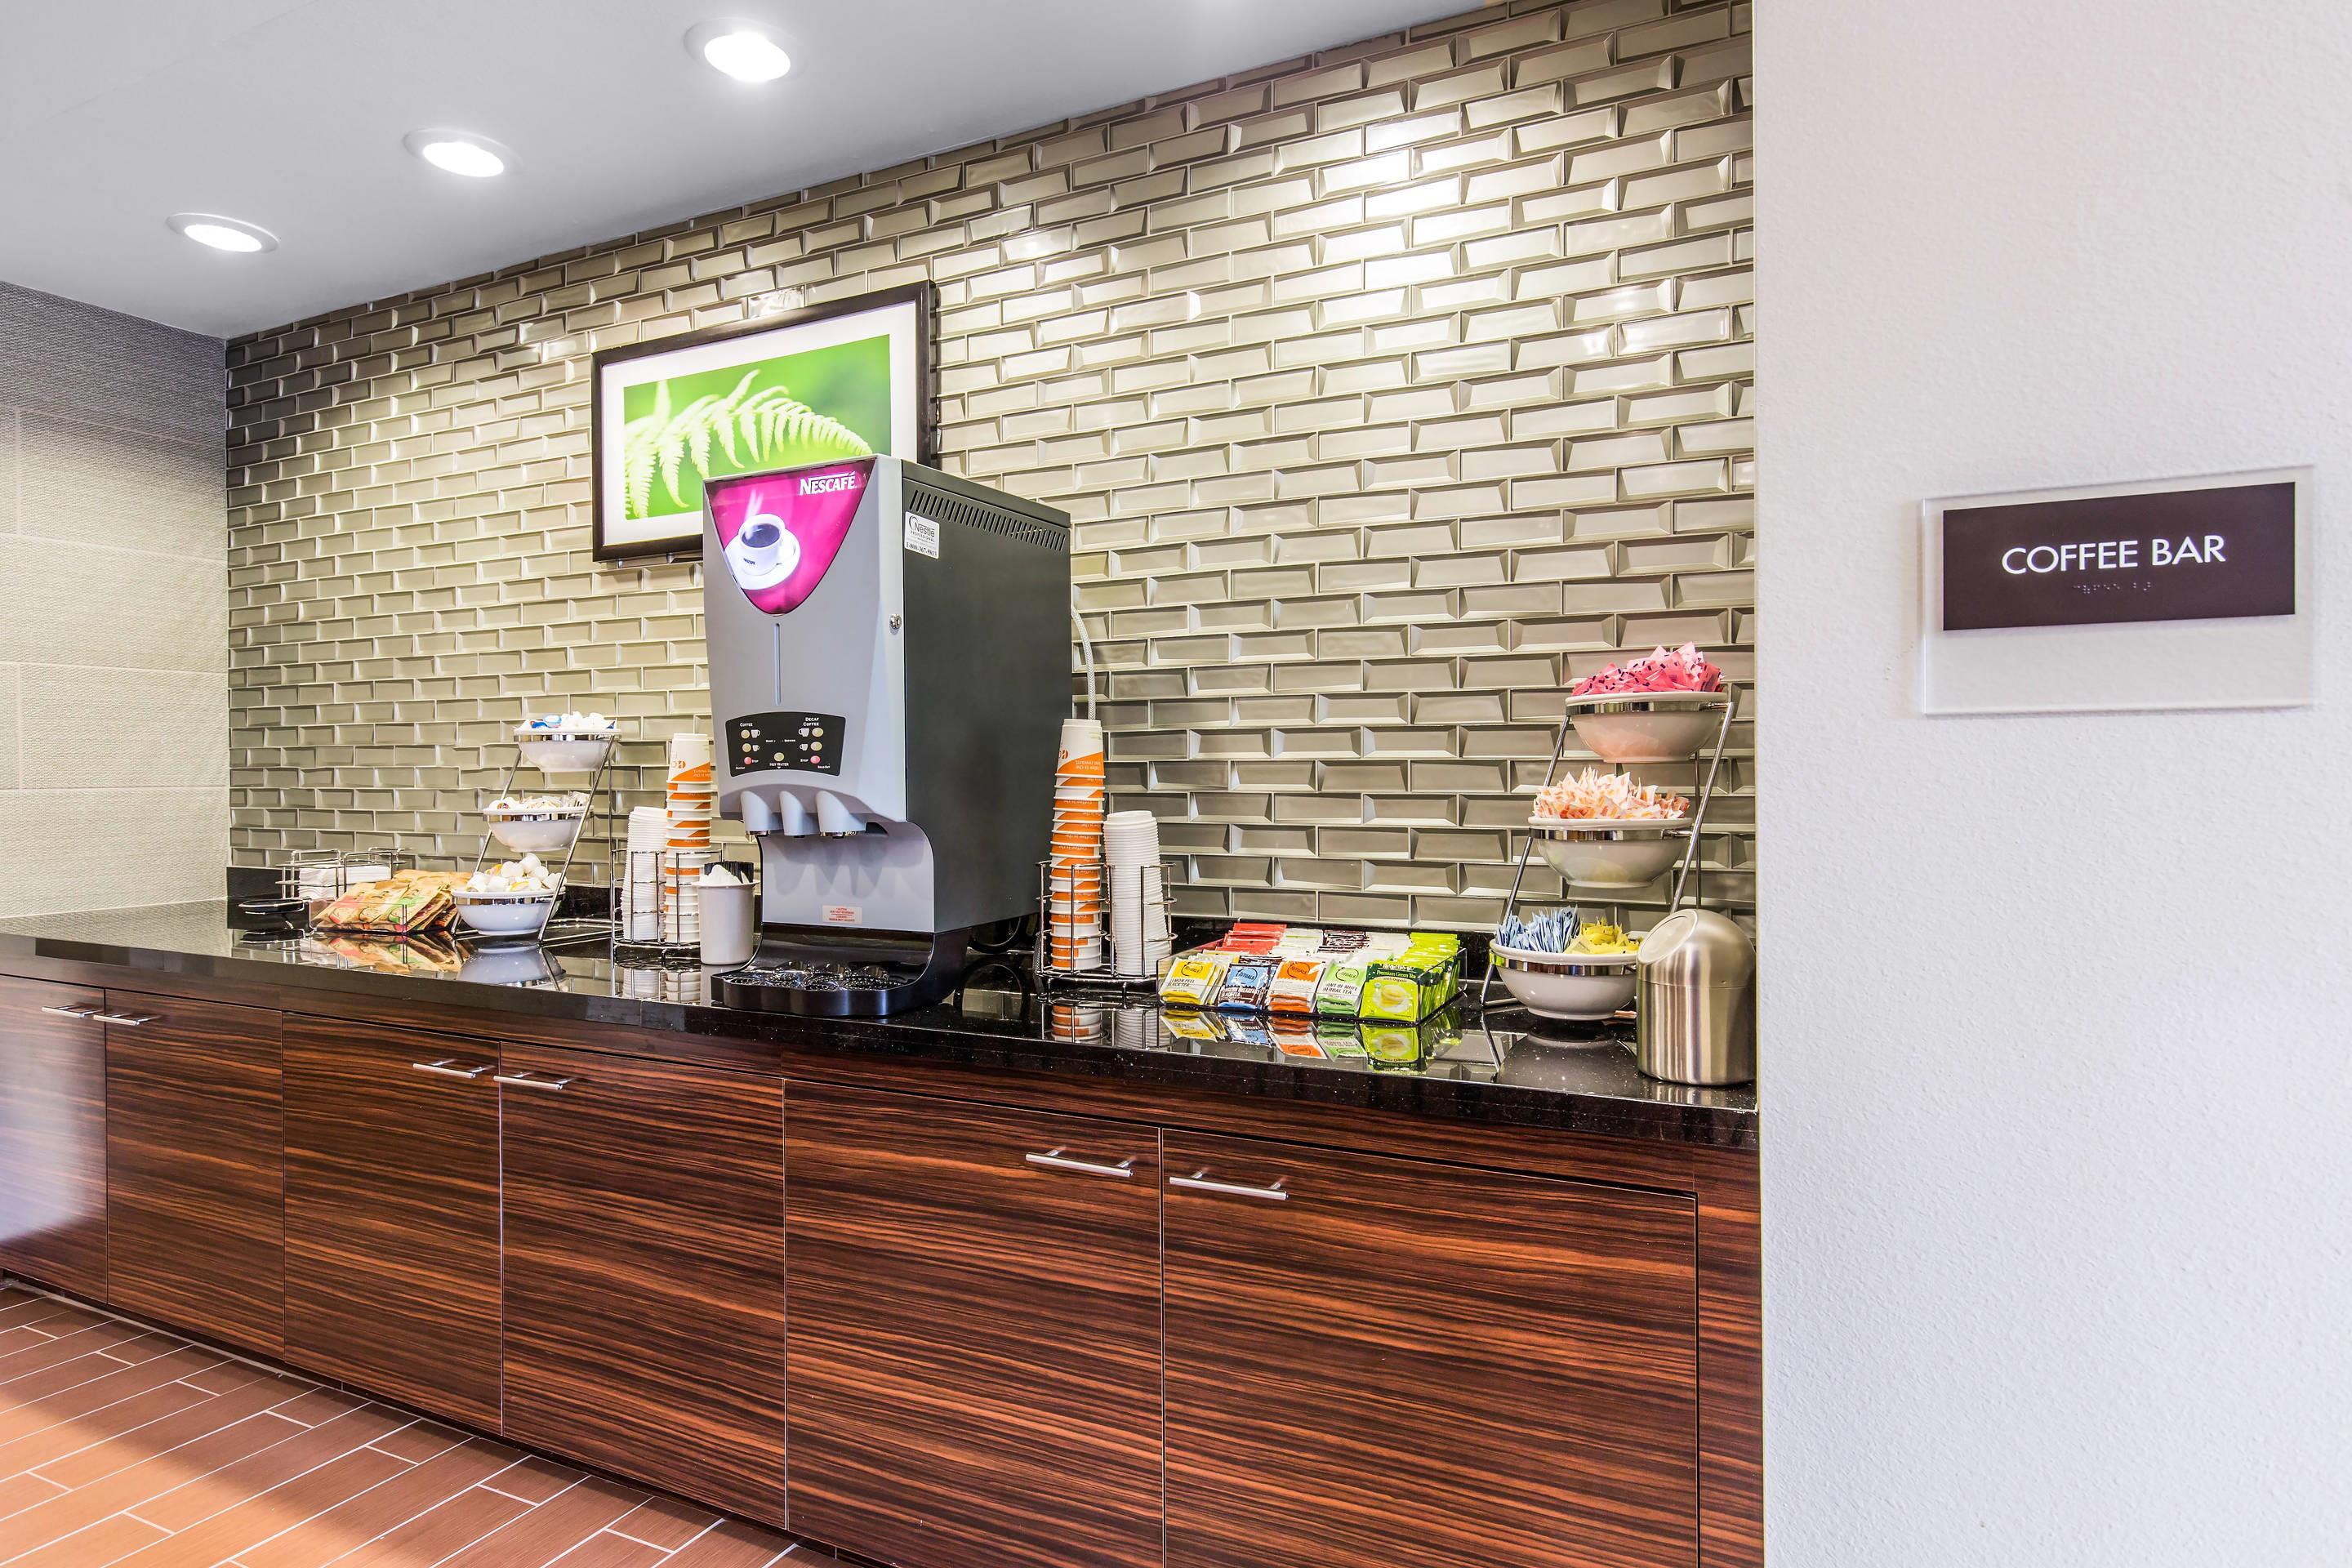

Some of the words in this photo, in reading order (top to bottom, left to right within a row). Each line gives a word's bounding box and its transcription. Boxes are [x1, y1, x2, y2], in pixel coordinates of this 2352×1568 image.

[800, 471, 856, 496] NESCAFÉ
[2002, 540, 2138, 574] COFFEE
[2151, 535, 2226, 566] BAR
